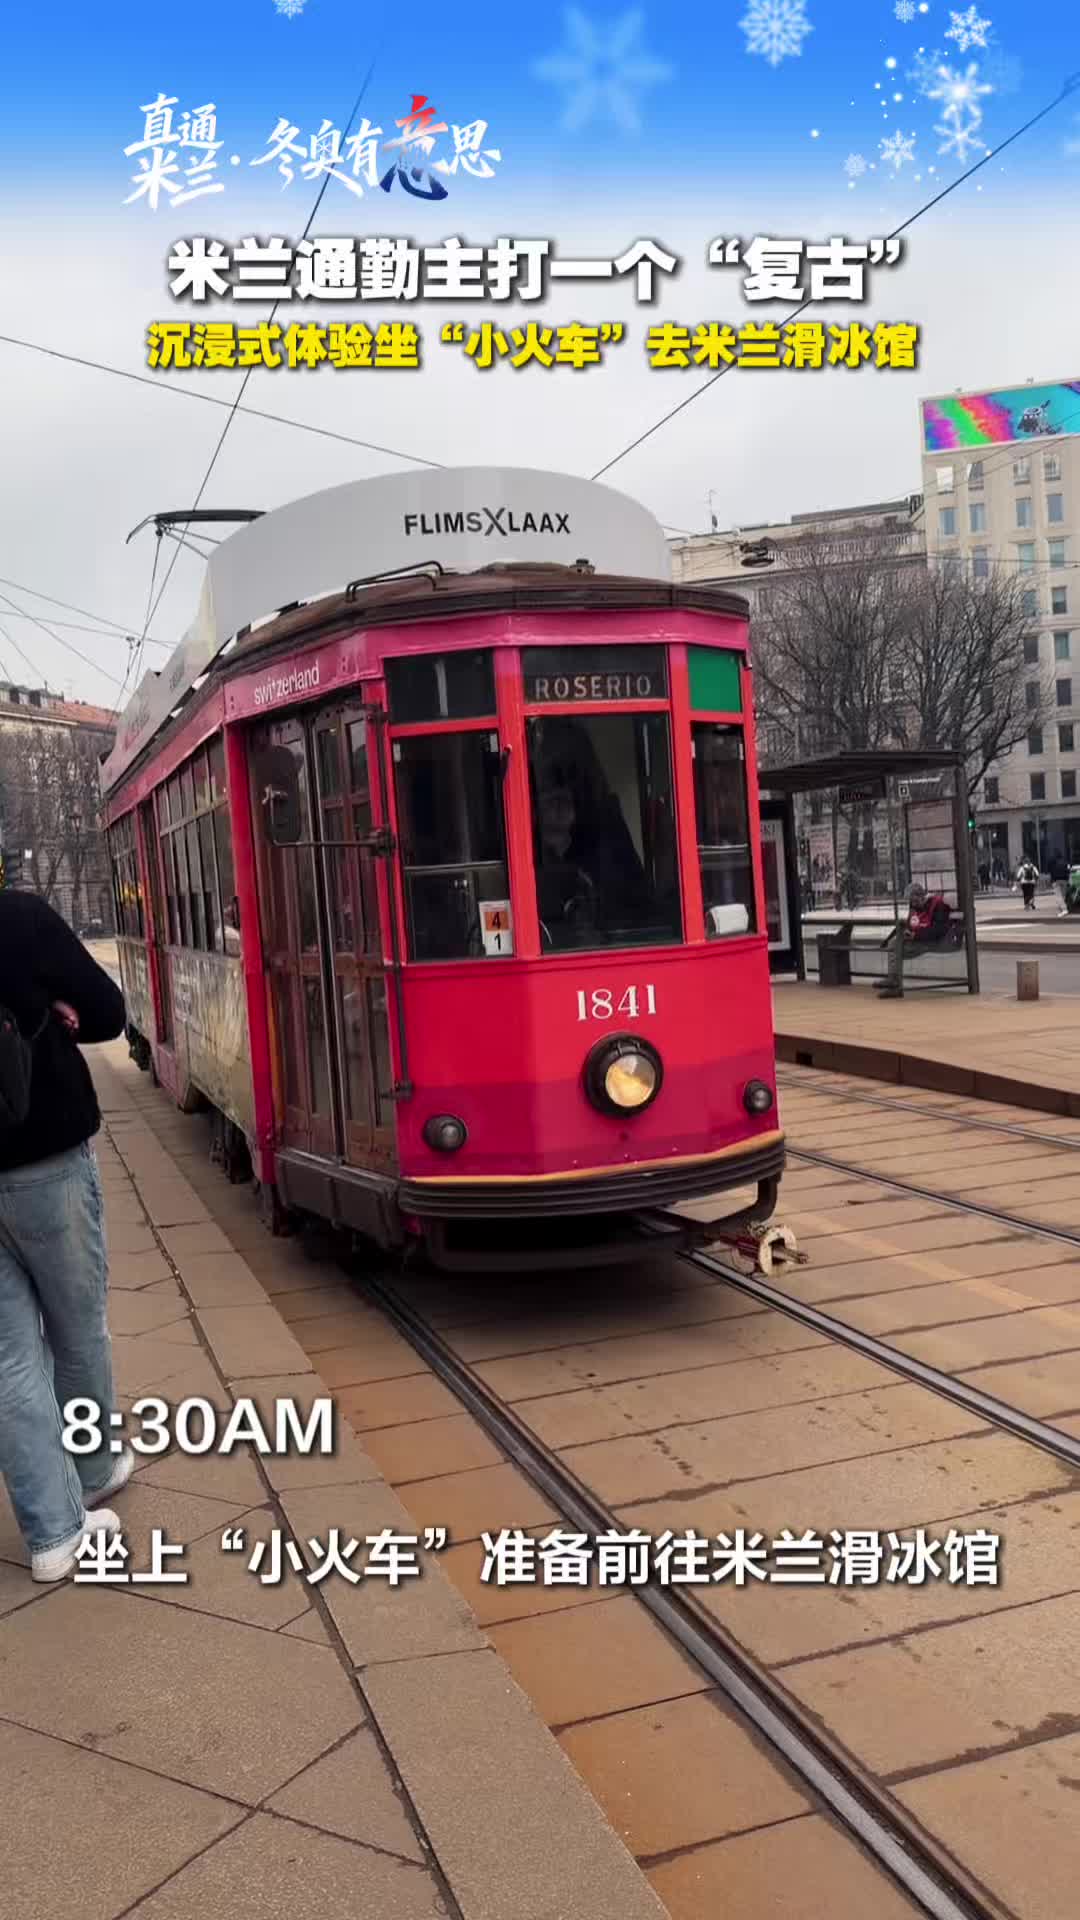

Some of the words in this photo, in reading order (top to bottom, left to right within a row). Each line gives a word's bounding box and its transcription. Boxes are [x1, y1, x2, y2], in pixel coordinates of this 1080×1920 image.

[535, 674, 652, 700] ROSERIO
[492, 911, 501, 929] 4
[494, 933, 501, 951] 1
[576, 984, 657, 1022] 1841
